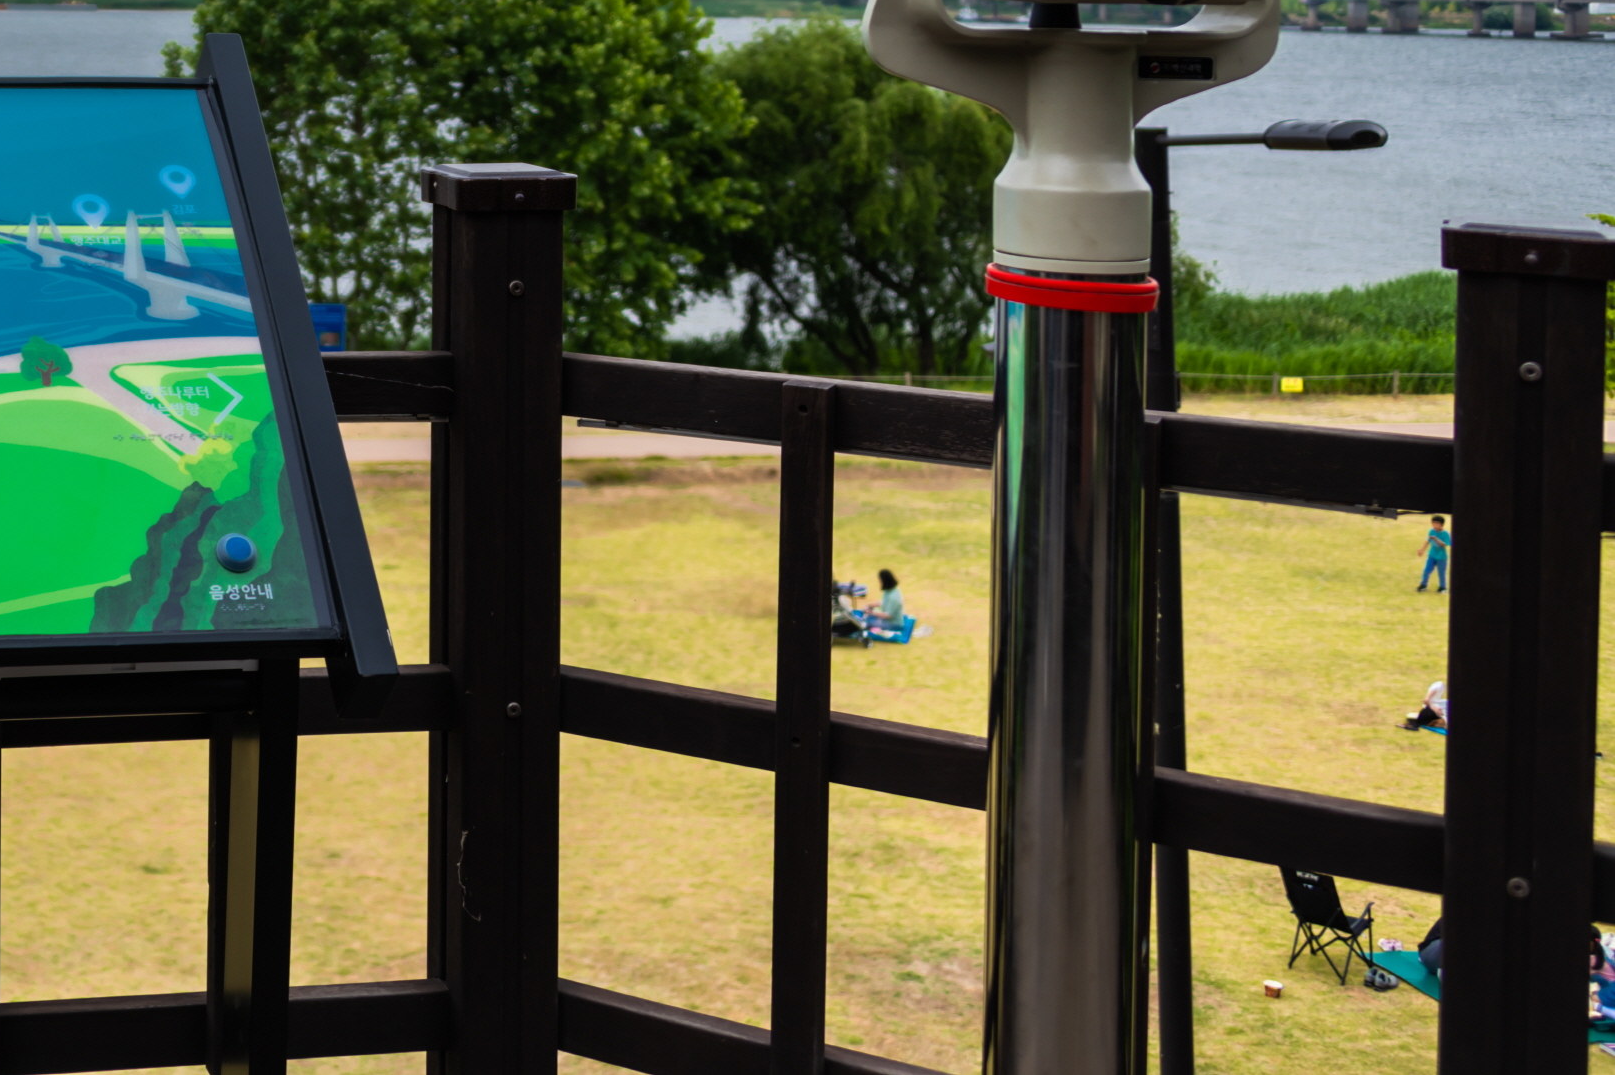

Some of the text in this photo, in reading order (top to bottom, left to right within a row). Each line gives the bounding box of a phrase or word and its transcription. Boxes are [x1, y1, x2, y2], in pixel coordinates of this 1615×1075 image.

[171, 204, 197, 215] 김포
[69, 234, 123, 247] 행주대교
[139, 385, 210, 400] 행주나루터
[209, 582, 274, 602] 음성안내
